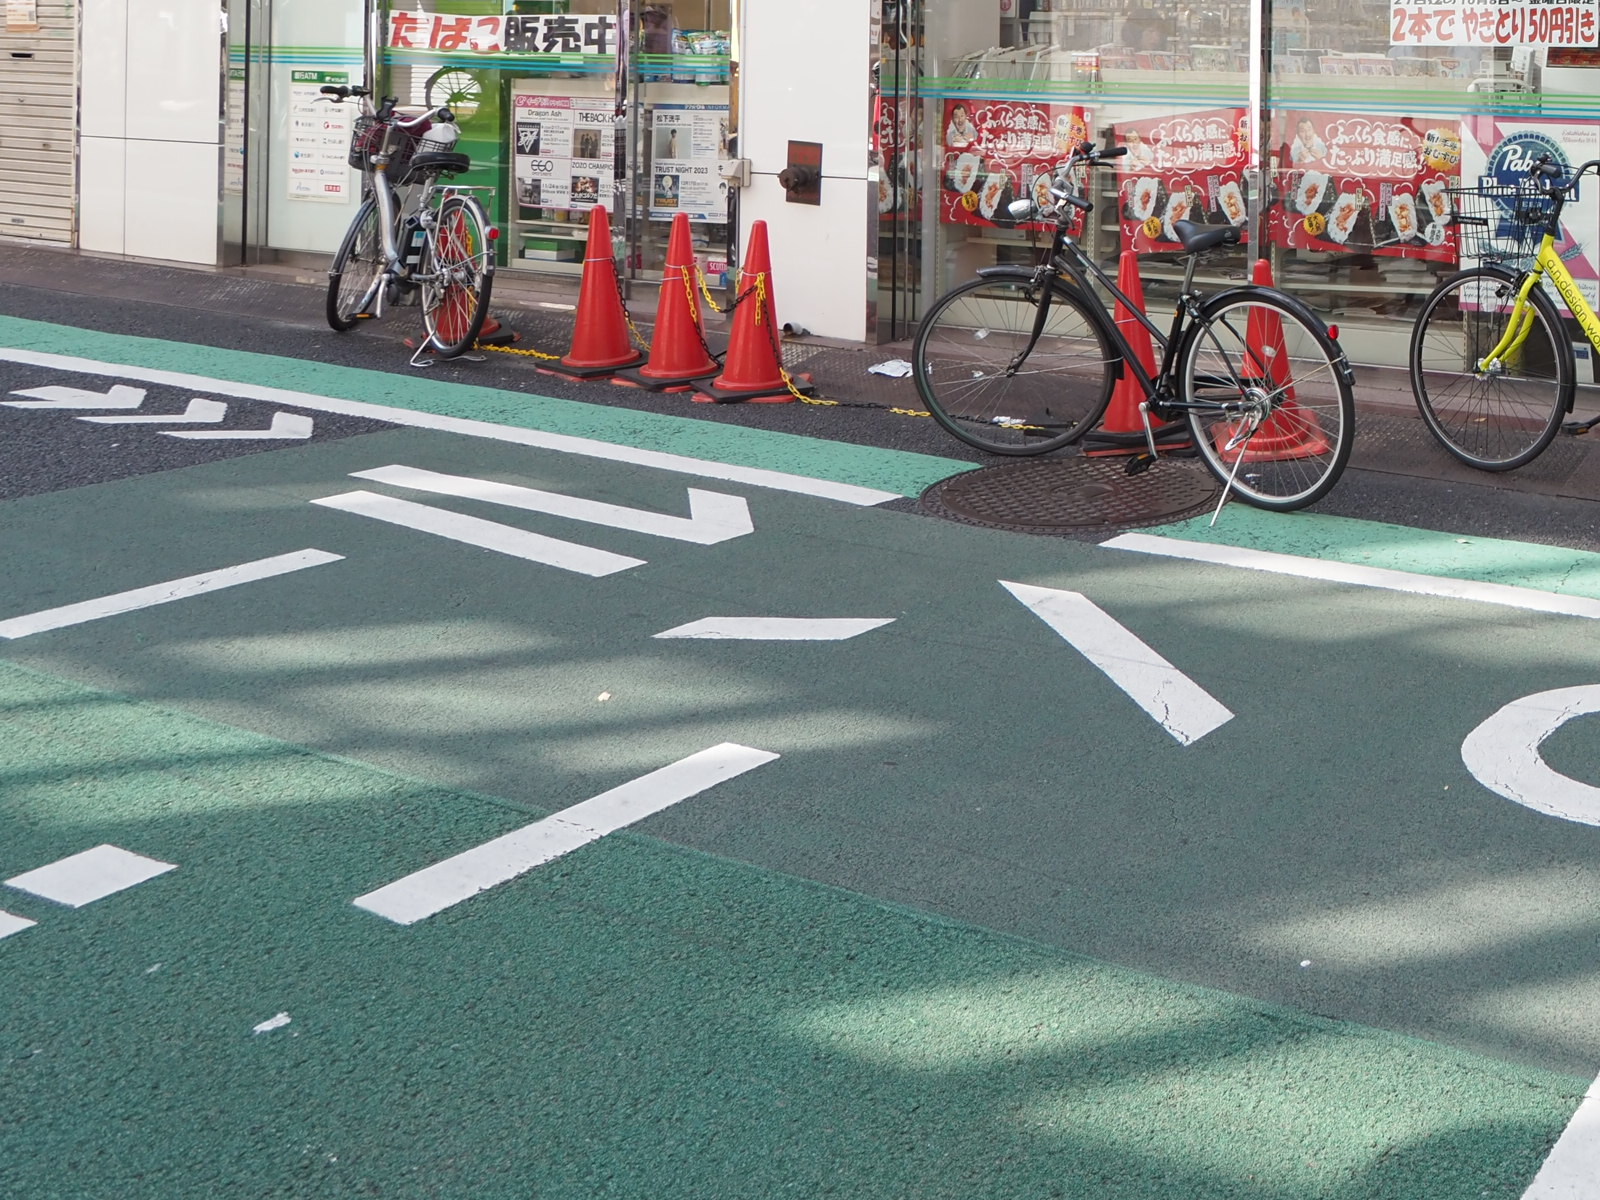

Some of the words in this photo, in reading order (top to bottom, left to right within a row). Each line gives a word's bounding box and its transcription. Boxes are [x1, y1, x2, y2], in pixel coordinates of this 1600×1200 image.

[1392, 7, 1455, 43] 2本で
[1462, 7, 1524, 44] やきとり
[1528, 7, 1595, 44] 50円引き
[655, 166, 674, 174] TRUST
